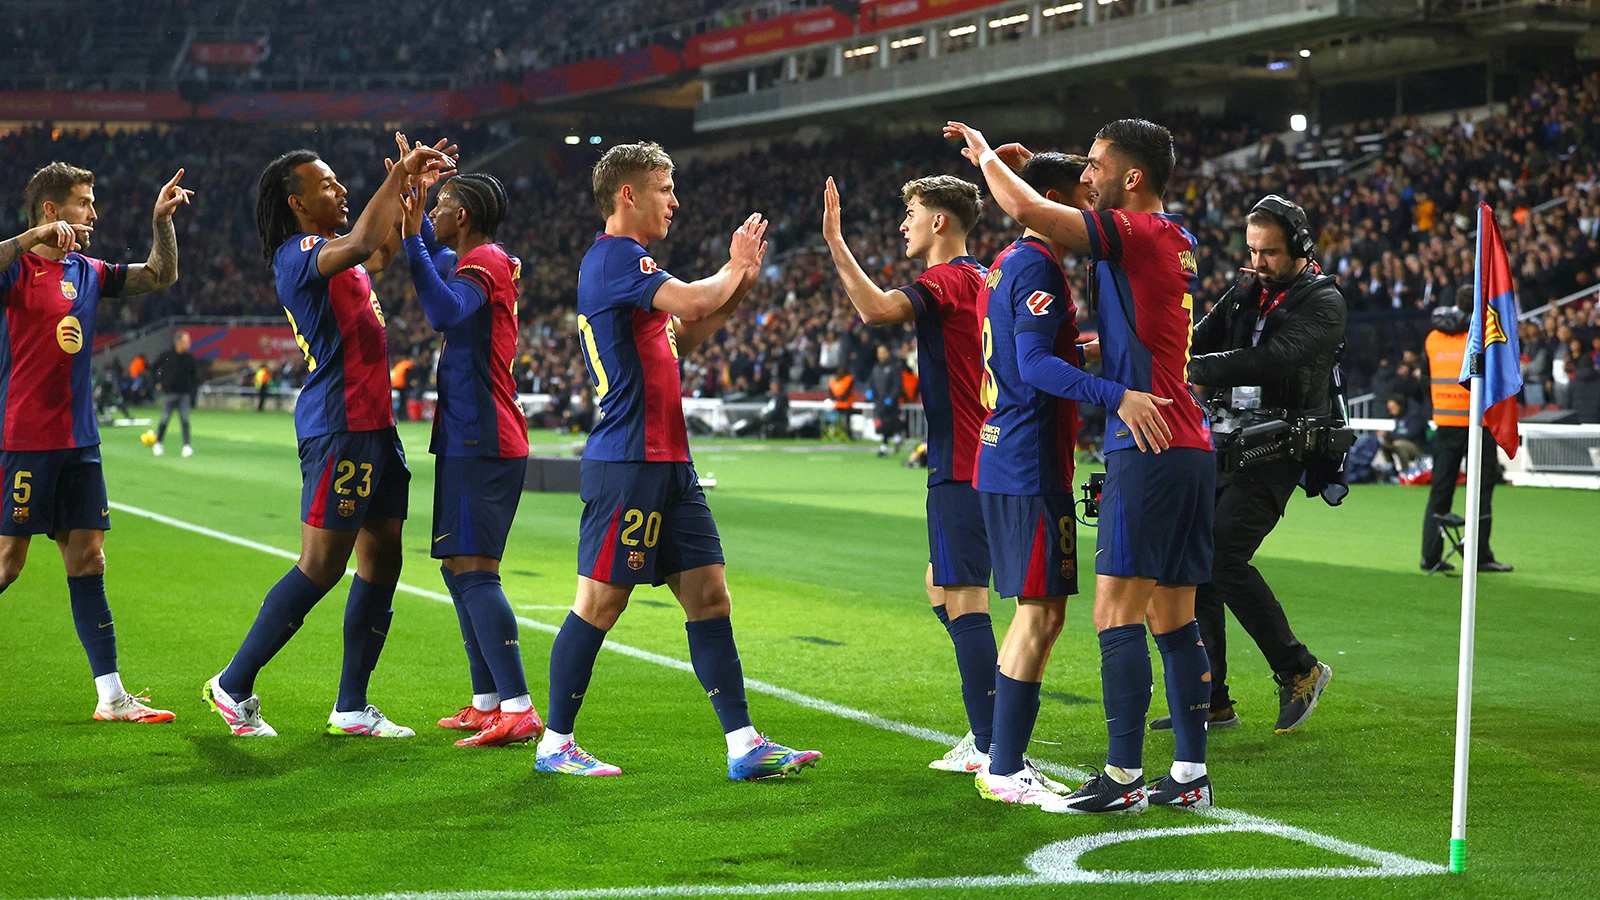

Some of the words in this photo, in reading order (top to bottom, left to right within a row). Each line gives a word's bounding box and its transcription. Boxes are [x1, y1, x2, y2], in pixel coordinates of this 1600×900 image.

[980, 316, 999, 414] 8
[12, 470, 33, 504] 5
[333, 459, 374, 498] 23
[620, 508, 663, 548] 20
[1058, 515, 1076, 555] 8
